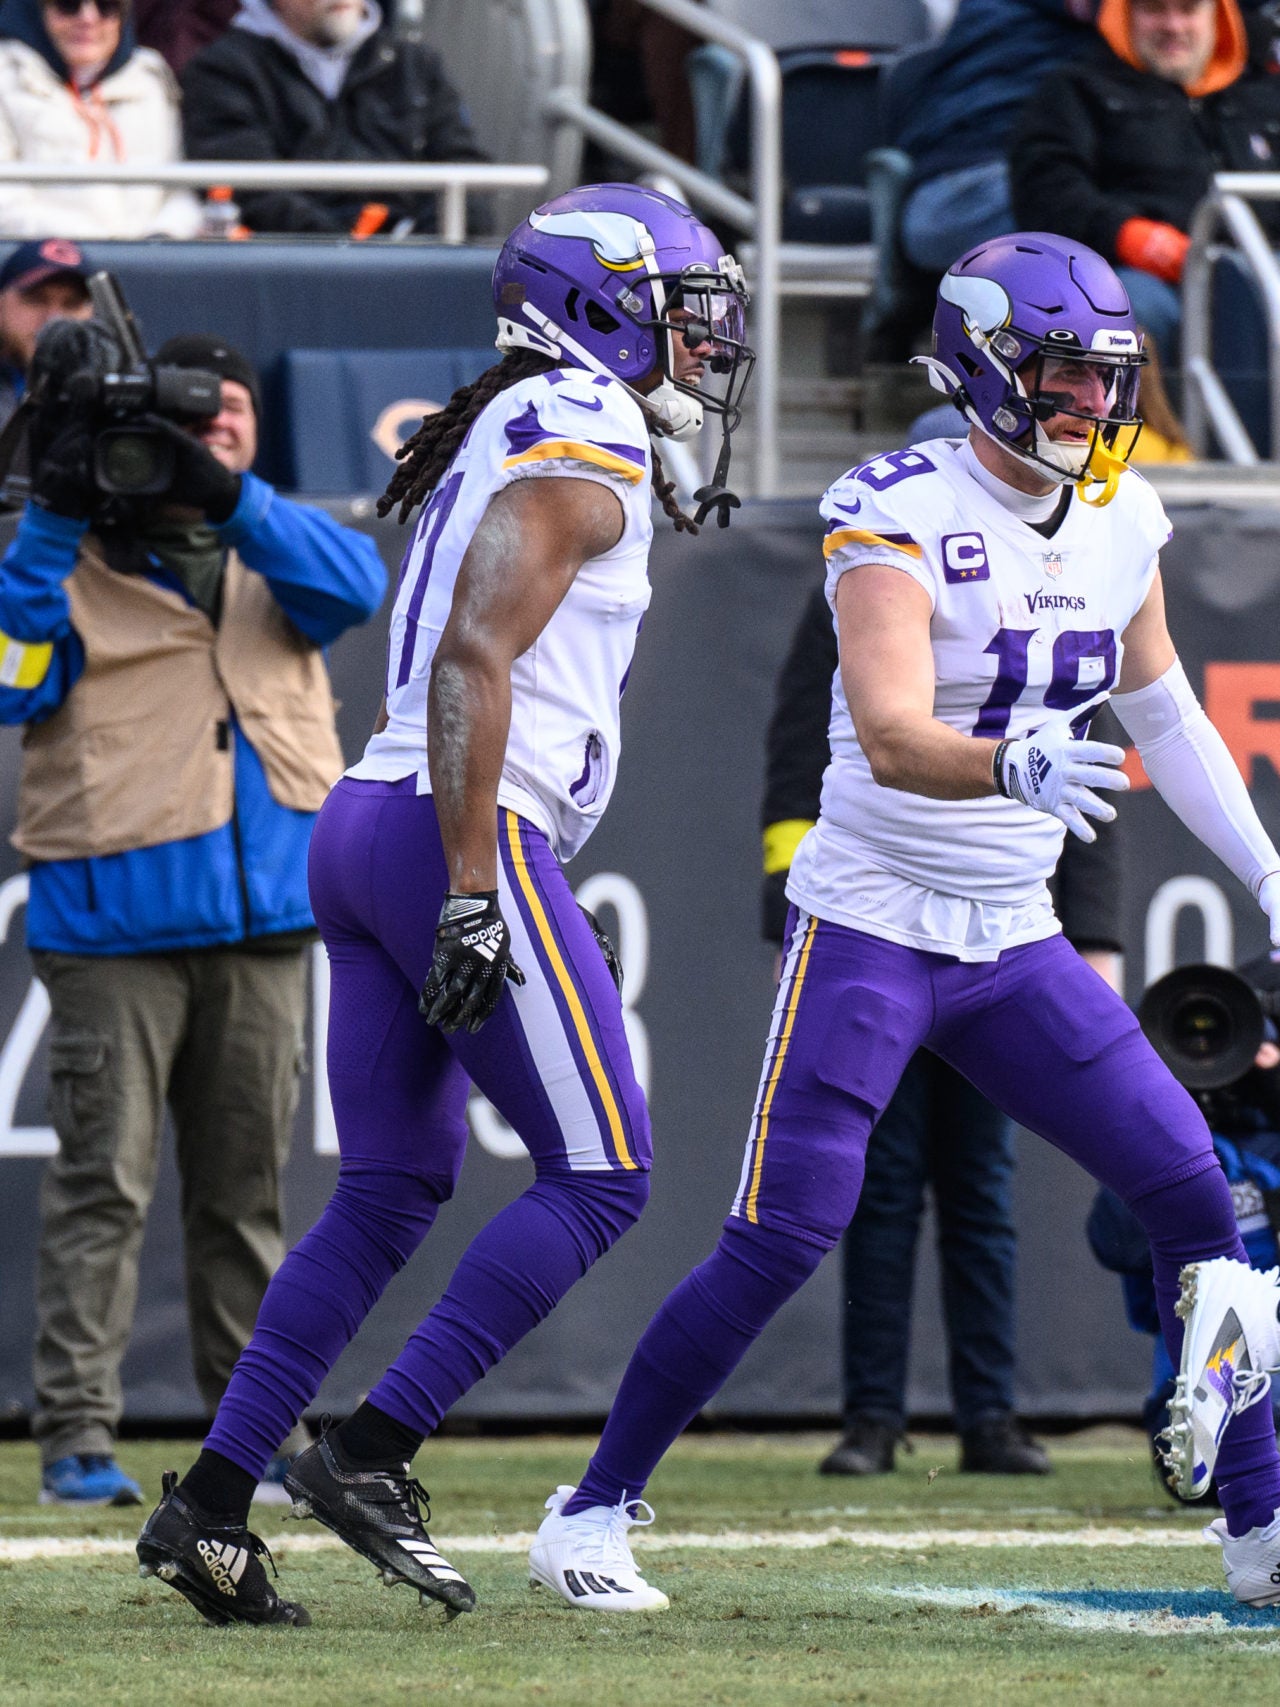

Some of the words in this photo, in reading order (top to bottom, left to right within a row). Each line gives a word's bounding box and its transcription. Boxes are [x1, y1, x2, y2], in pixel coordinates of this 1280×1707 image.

[946, 535, 986, 570] C
[972, 628, 1117, 740] 19
[1028, 746, 1041, 796] adidas
[461, 920, 504, 947] adidas
[197, 1539, 237, 1597] adidas
